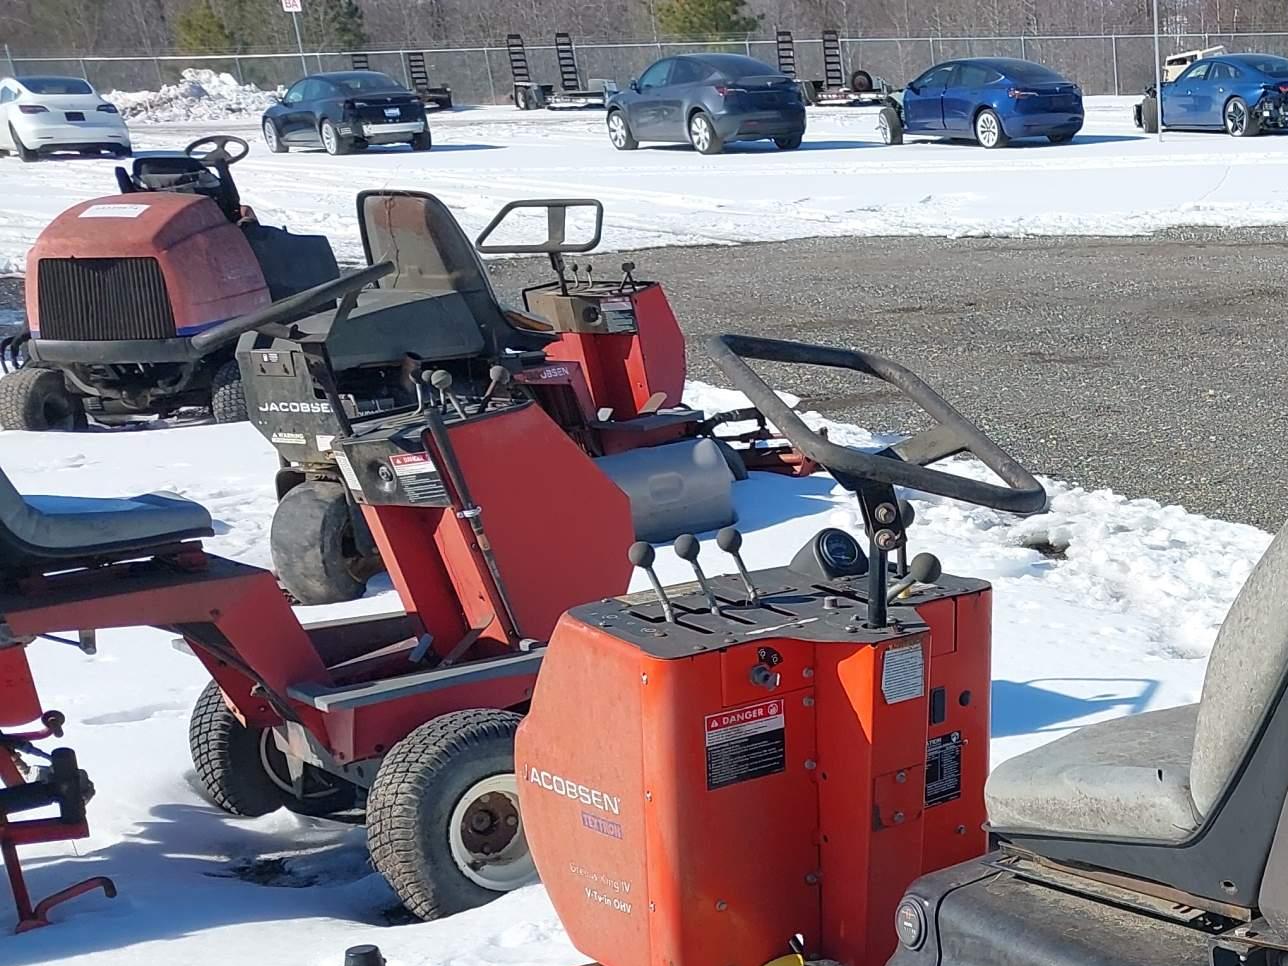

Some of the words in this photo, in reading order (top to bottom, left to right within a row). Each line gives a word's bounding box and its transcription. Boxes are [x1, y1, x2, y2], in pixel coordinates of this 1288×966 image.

[258, 402, 334, 413] JACOBSE
[722, 708, 764, 725] DANGER
[524, 763, 621, 815] JACOBSEN
[582, 813, 623, 839] TEXTRON
